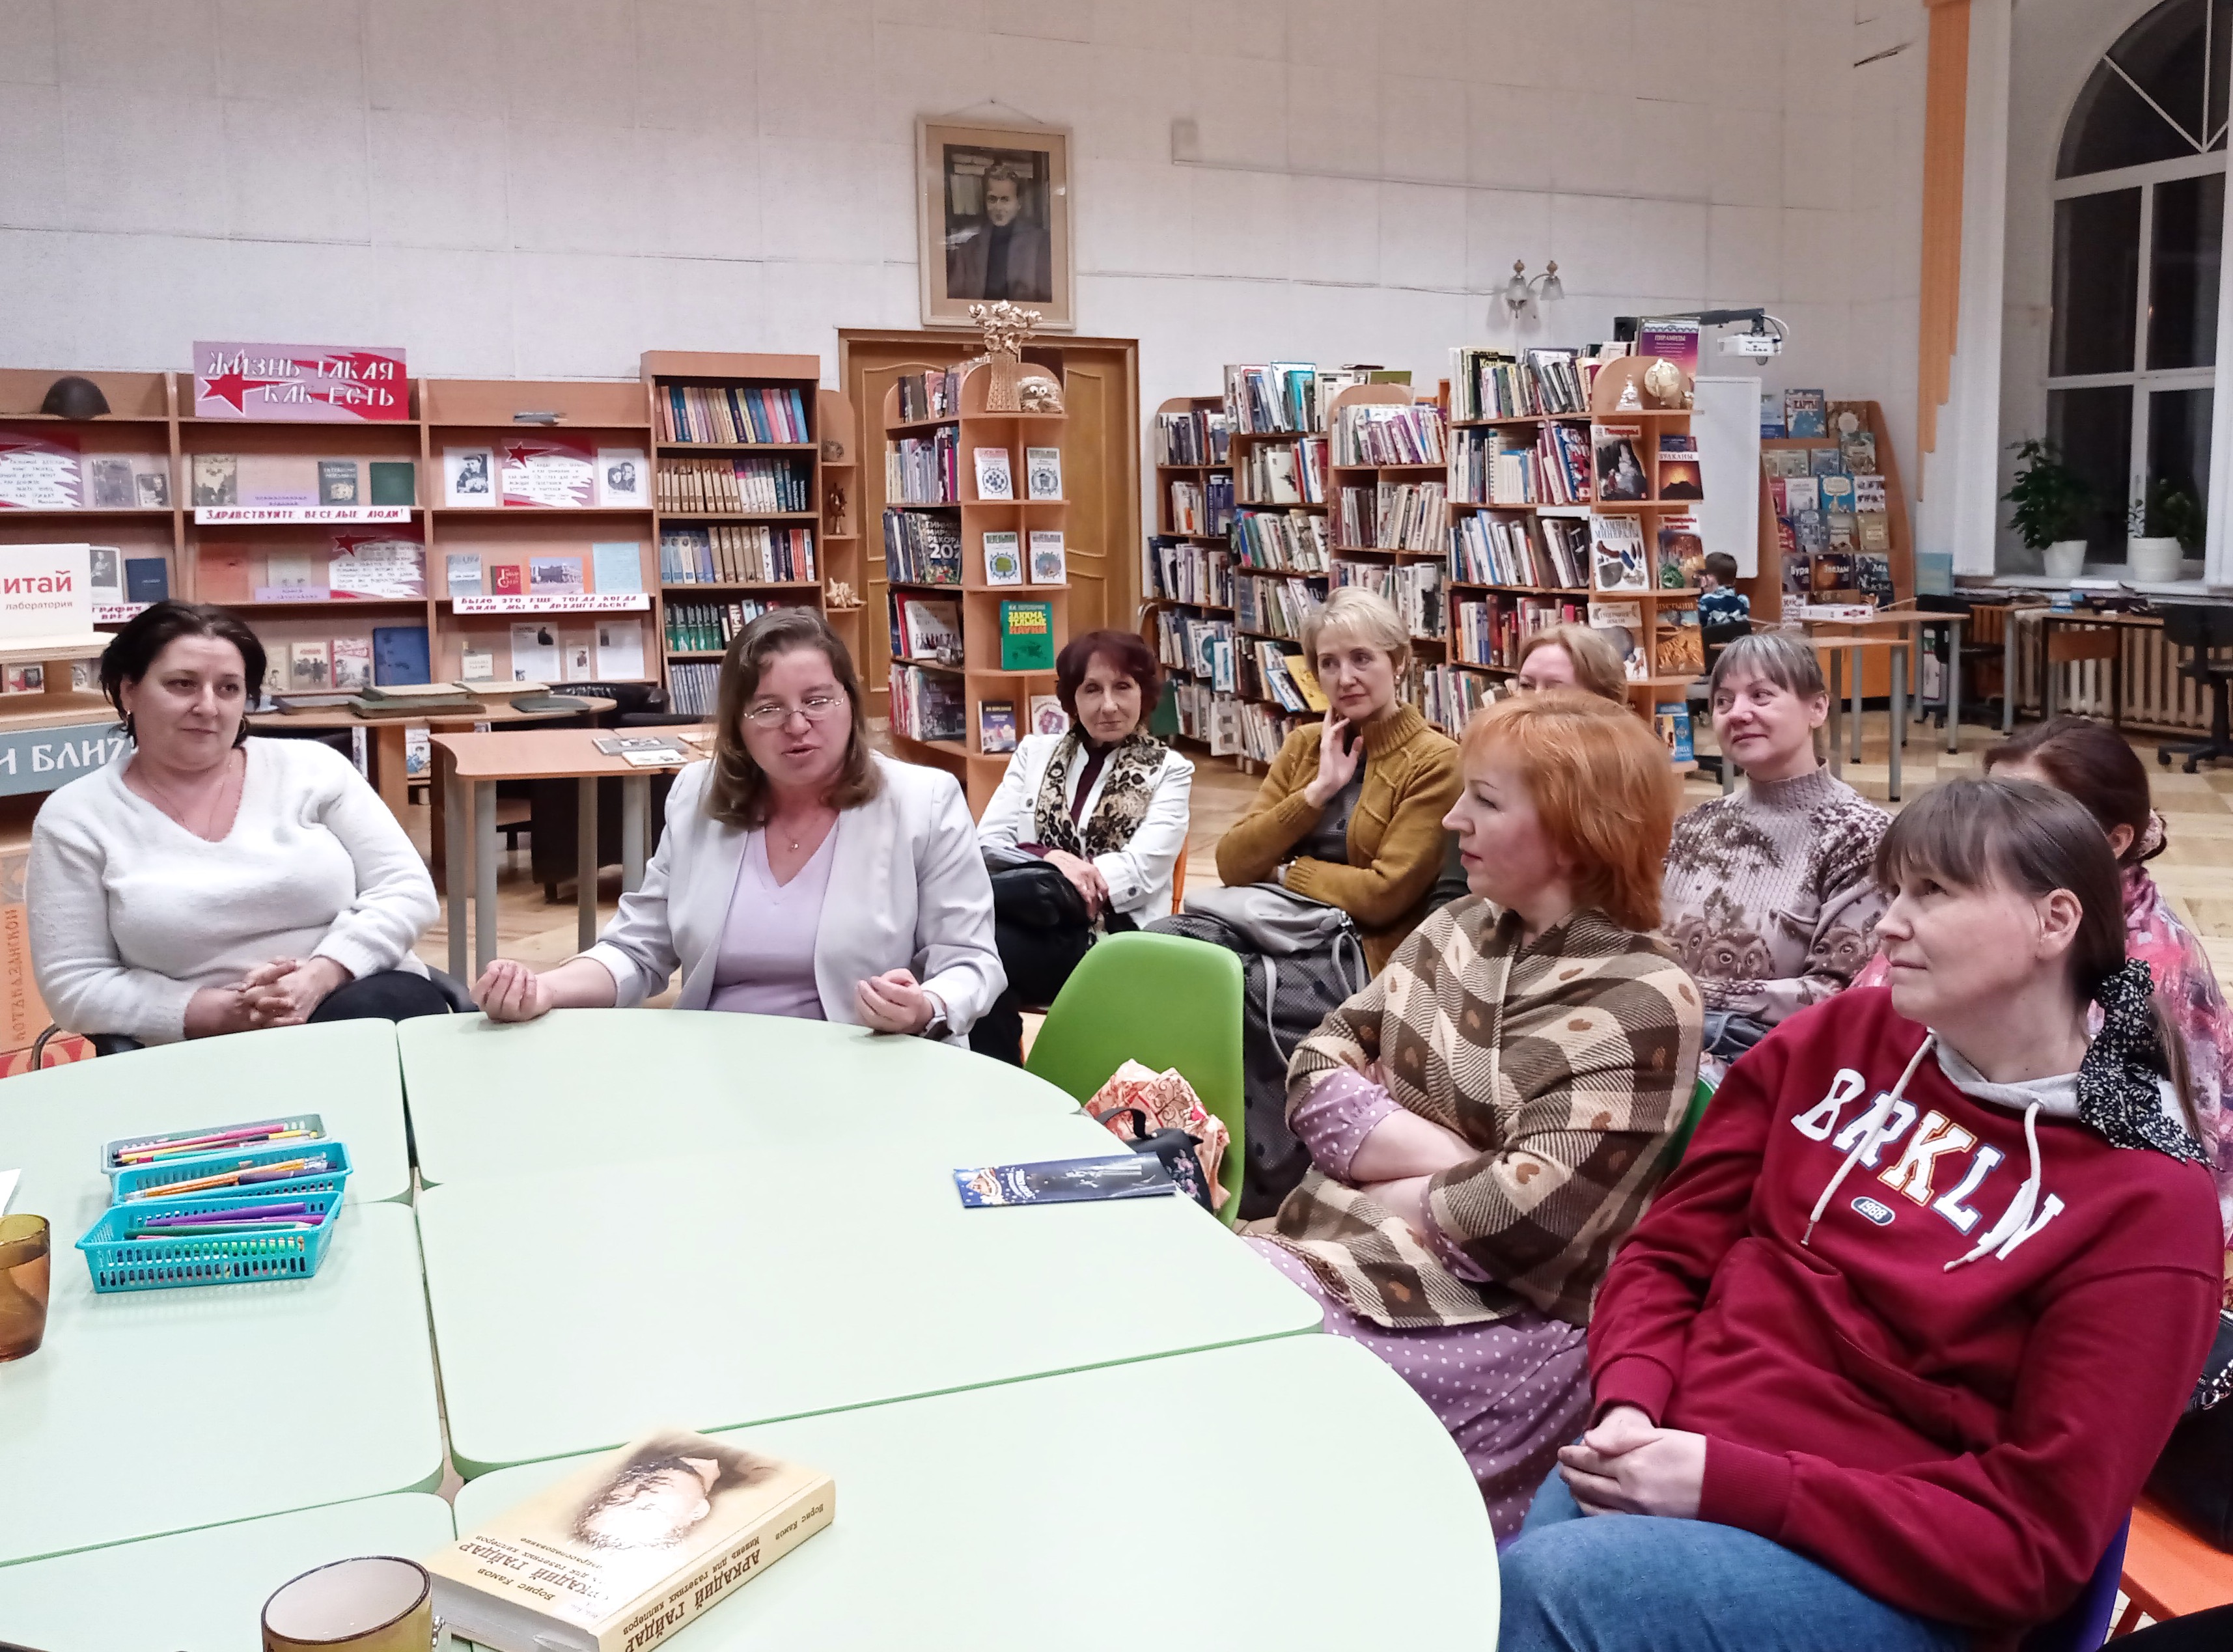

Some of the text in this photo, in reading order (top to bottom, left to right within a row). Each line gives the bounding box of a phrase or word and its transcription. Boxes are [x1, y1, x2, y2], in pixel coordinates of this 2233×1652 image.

[207, 350, 394, 380] ЖИЗНЬ ТАКАЯ
[264, 383, 395, 406] КАК ЕСТЬ
[367, 508, 403, 519] ЛЮДИ!
[0, 570, 72, 594] итай
[6, 601, 73, 610] лаборатория
[1790, 1067, 2065, 1261] BRKLN
[1857, 1200, 1888, 1220] 1988
[775, 1503, 824, 1541] Борис Камов
[475, 1535, 590, 1578] для газетных киллеров
[731, 1536, 760, 1560] Мишень
[458, 1542, 609, 1601] КАДИЙ ГАЙДАР
[712, 1556, 728, 1574] для
[477, 1567, 556, 1601] Борис Камов
[668, 1571, 710, 1604] газетных
[624, 1548, 761, 1652] АРКАДИЙ ГАЙДАР
[622, 1601, 665, 1636] киллеров
